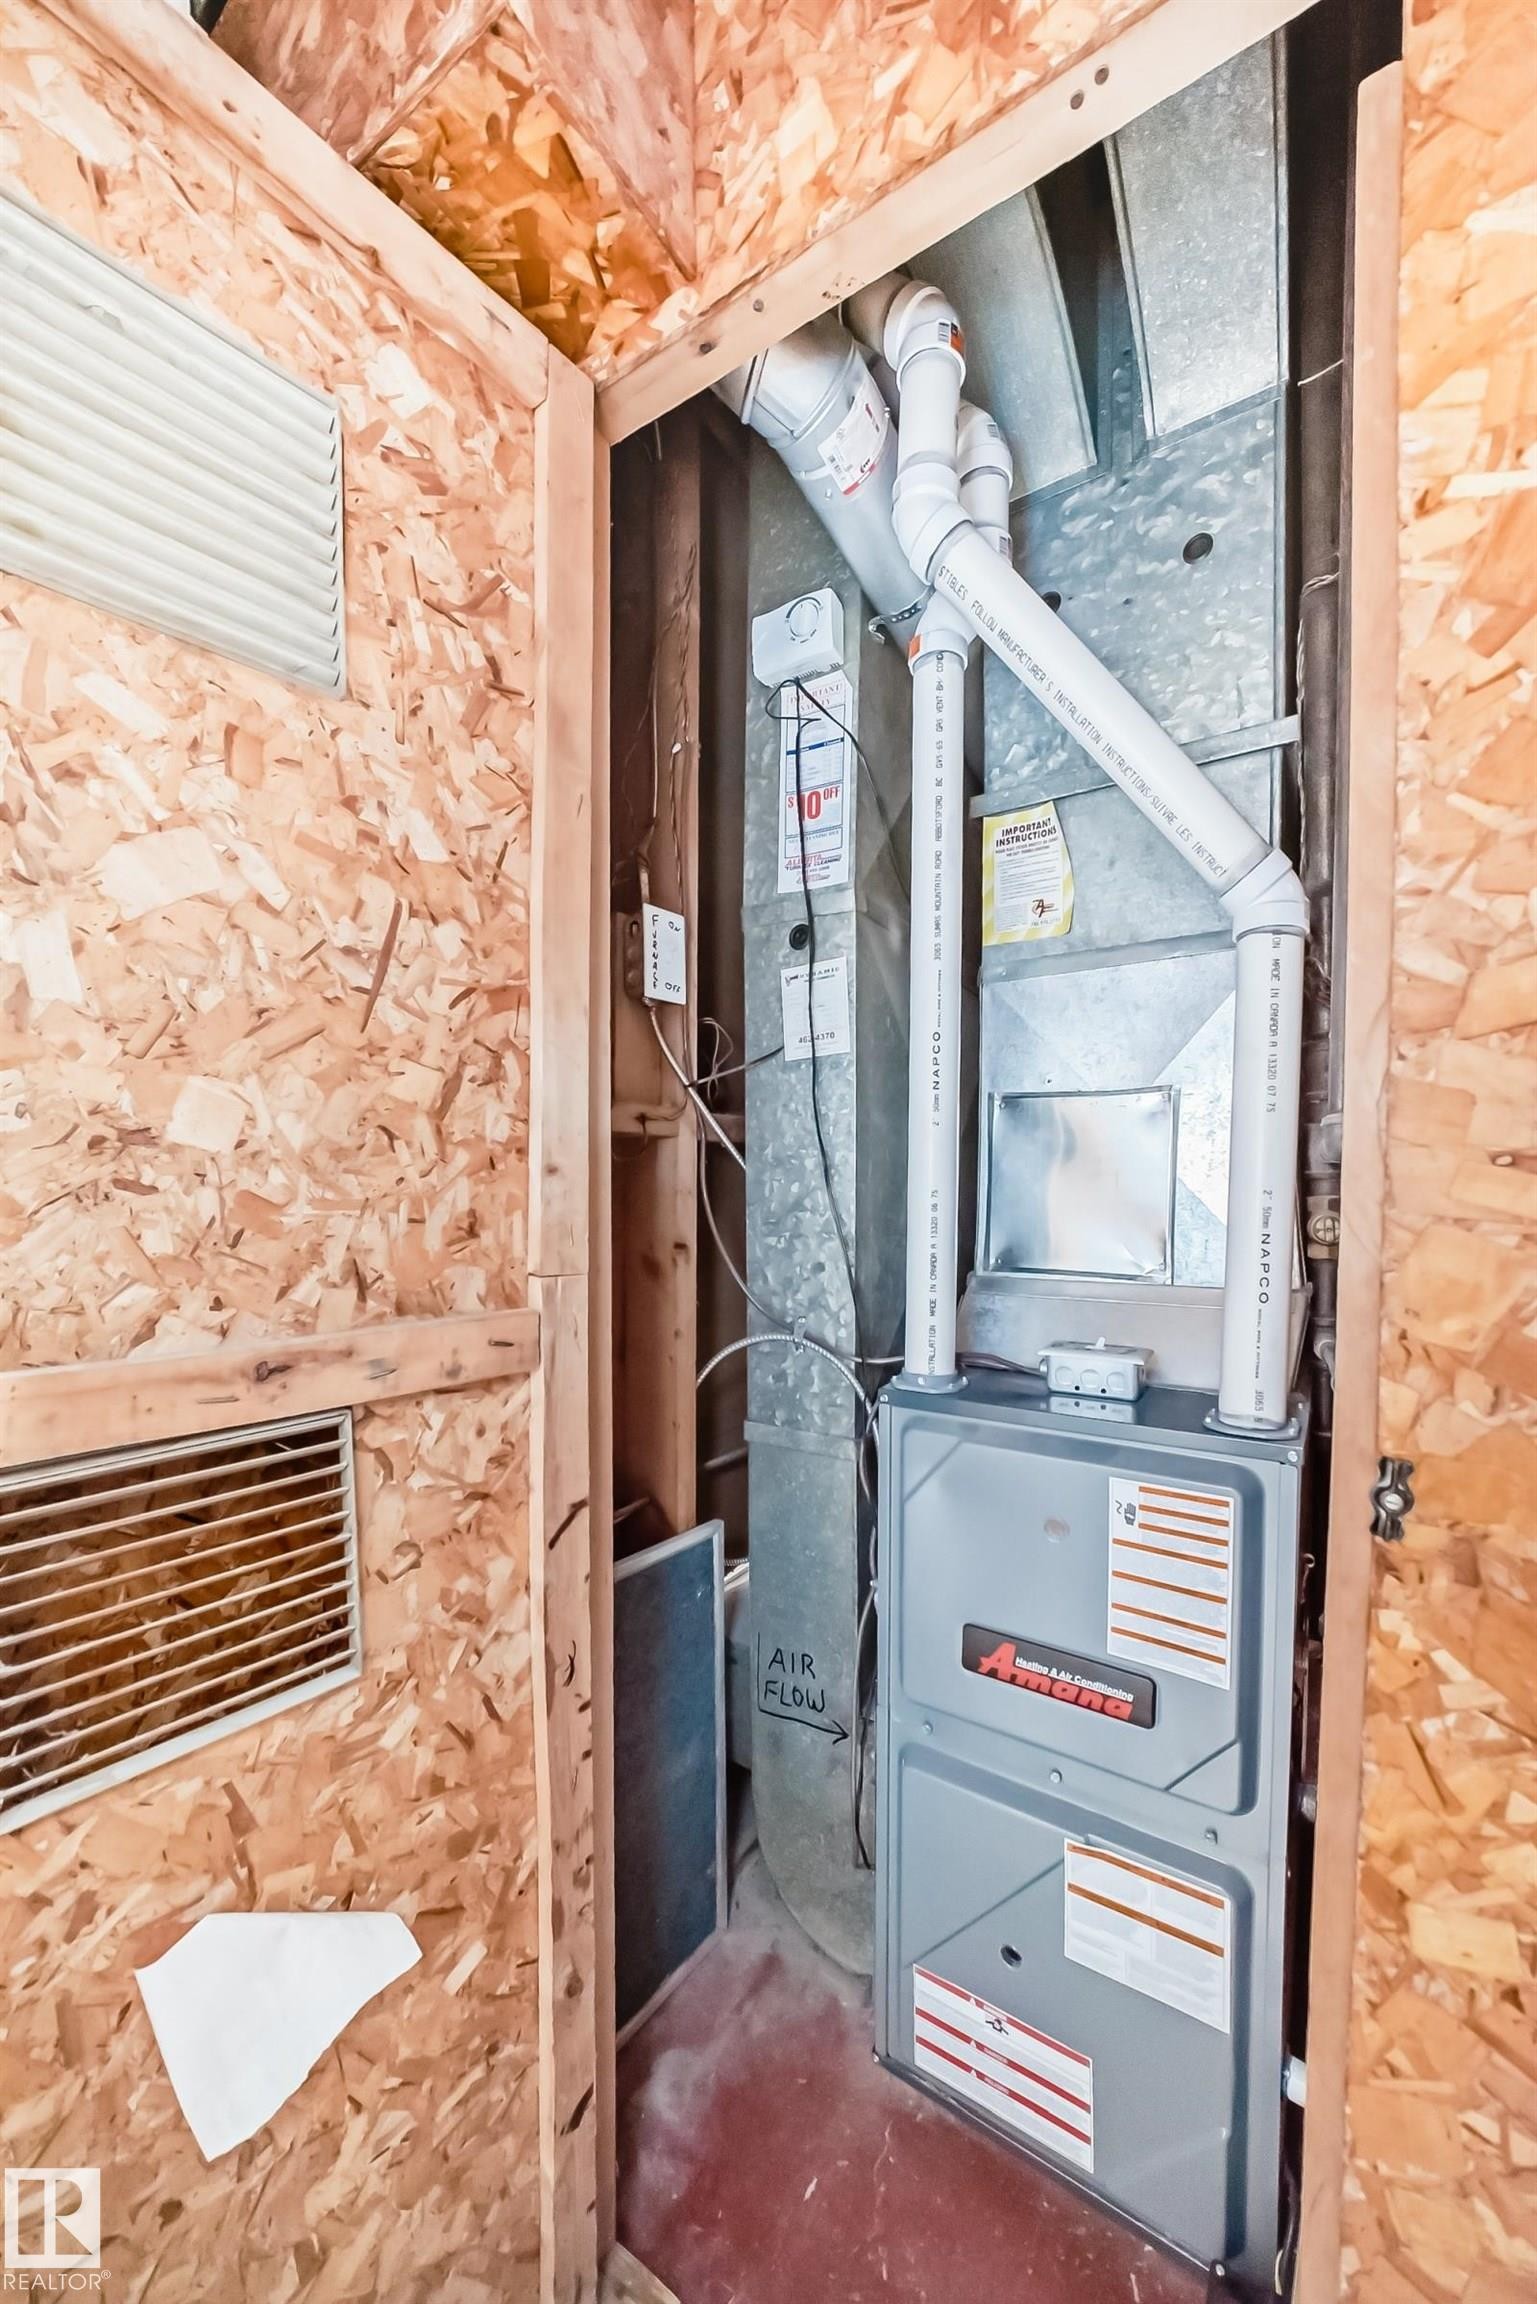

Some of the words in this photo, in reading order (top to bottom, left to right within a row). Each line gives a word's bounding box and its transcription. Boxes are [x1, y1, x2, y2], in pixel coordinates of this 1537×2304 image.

[970, 600, 998, 632] FOLLOW
[1053, 689, 1103, 744] INSTALLATION
[1175, 824, 1193, 842] LES
[823, 786, 841, 800] OFF
[936, 777, 943, 787] BC
[935, 795, 943, 842] ABBOTSFORD
[1001, 818, 1051, 837] IMPORTANT
[995, 826, 1057, 848] INSTRUCTIONS
[934, 850, 942, 870] ROAD
[934, 872, 942, 911] MOUNTAIN
[1271, 959, 1280, 982] MADE
[1270, 988, 1280, 998] IN
[1269, 1003, 1279, 1036] CANADA
[932, 1031, 941, 1090] NAPCO
[1267, 1054, 1277, 1080] 13320
[1266, 1085, 1277, 1096] 07
[1262, 1207, 1272, 1229] 50mm
[1259, 1233, 1271, 1304] NAPCO
[930, 1284, 937, 1293] IN
[768, 1647, 816, 1679] AIR
[977, 1641, 1134, 1720] Amana
[1015, 1656, 1049, 1675] Heating
[1059, 1669, 1073, 1682] Air
[1074, 1674, 1134, 1702] Conditioning
[764, 1680, 825, 1713] FLOW
